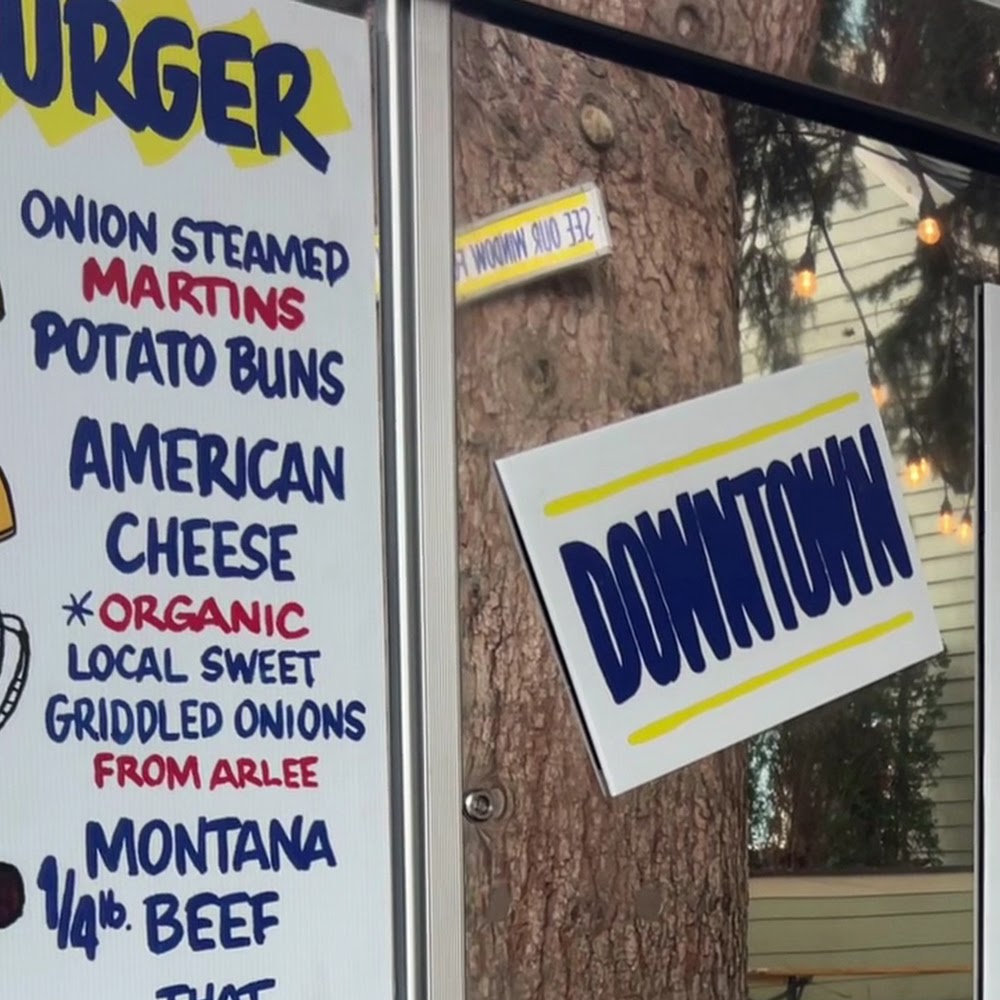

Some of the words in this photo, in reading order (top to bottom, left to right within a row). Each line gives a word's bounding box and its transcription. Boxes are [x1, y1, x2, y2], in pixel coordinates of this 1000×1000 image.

[21, 189, 157, 255] ONION
[171, 216, 349, 287] STEAMED
[82, 256, 306, 330] MARTINS
[31, 310, 217, 388] POTATO
[225, 336, 345, 406] BUNS
[69, 415, 345, 504] AMERICAN
[105, 511, 298, 582] CHEESE
[559, 423, 913, 705] DOWNTOWN
[67, 643, 188, 683] LOCAL
[200, 645, 321, 688] SWEET
[45, 694, 223, 745] GRIDDLED
[234, 698, 367, 741] ONIONS
[93, 752, 201, 790] FROM
[209, 756, 319, 791] ARLEE
[86, 814, 337, 879] MONTANA
[143, 891, 279, 955] BEEF
